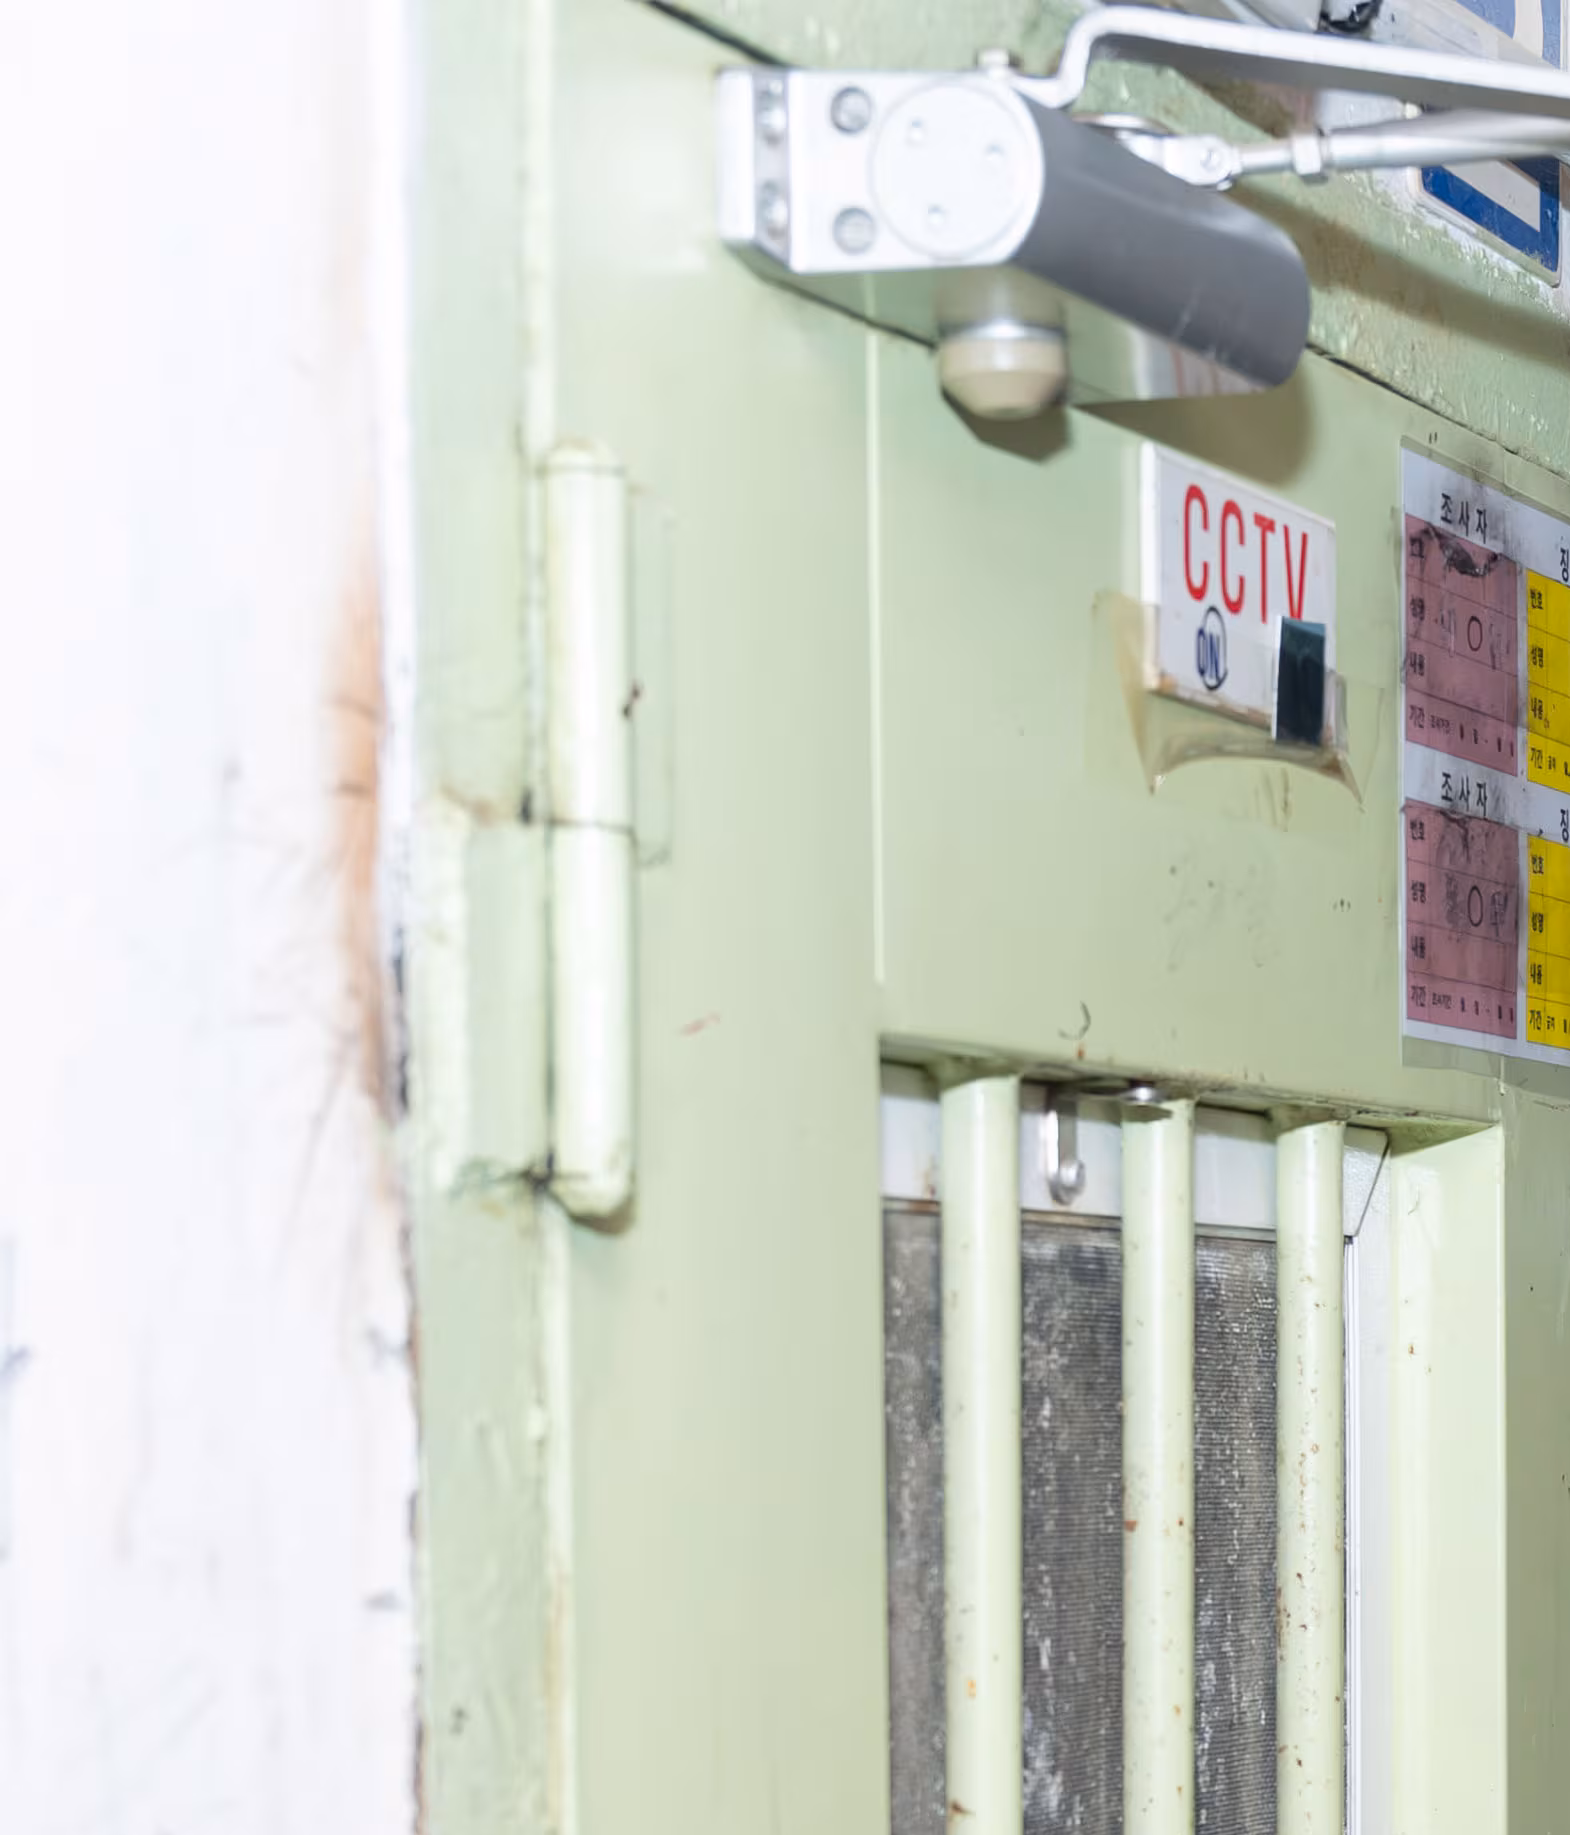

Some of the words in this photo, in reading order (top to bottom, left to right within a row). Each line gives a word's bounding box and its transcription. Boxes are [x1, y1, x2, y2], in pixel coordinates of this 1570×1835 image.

[1440, 492, 1488, 545] 조사자
[1184, 484, 1308, 624] CCTV
[1409, 704, 1425, 729] 기간
[1530, 746, 1543, 770] 기간
[1440, 771, 1488, 817] 조사자
[1410, 984, 1427, 1008] 기간
[1529, 1009, 1543, 1031] 기간
